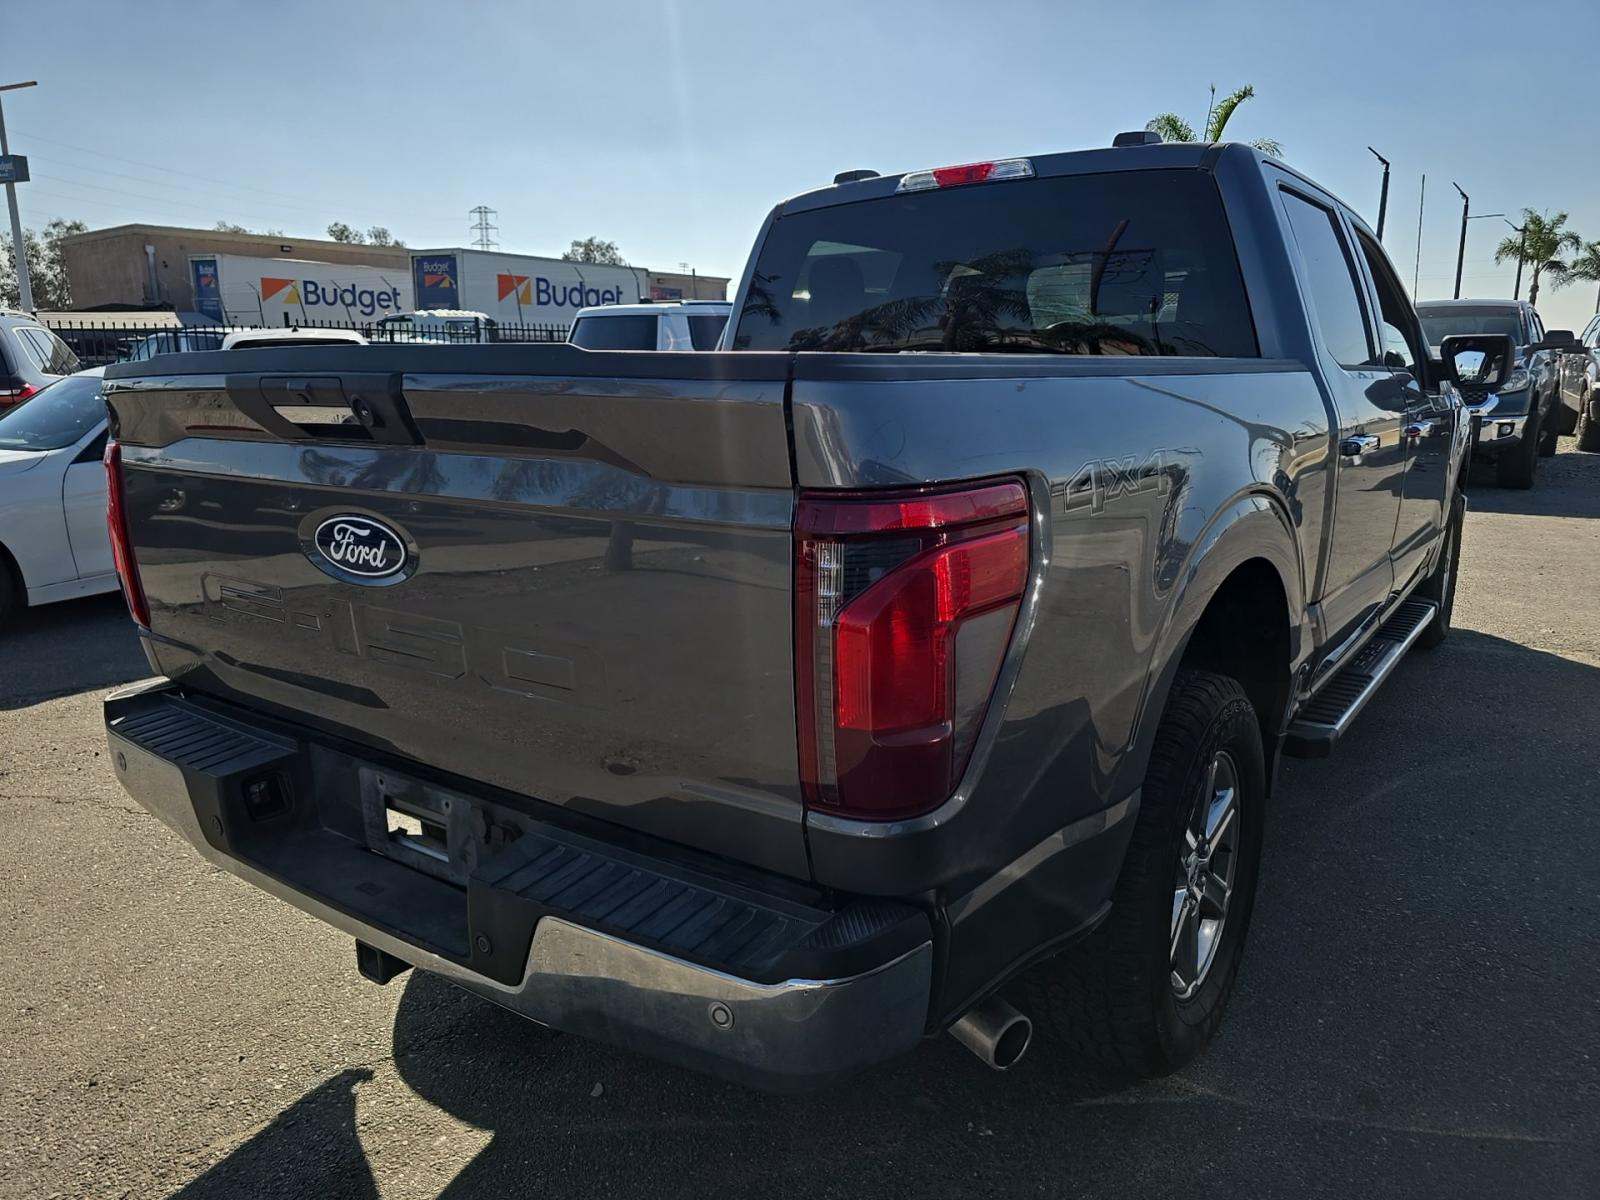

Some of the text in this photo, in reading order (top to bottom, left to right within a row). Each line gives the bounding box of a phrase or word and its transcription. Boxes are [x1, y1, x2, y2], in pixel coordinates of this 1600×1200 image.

[302, 280, 402, 316] Budget
[535, 277, 624, 308] Budget
[330, 523, 387, 568] Ford
